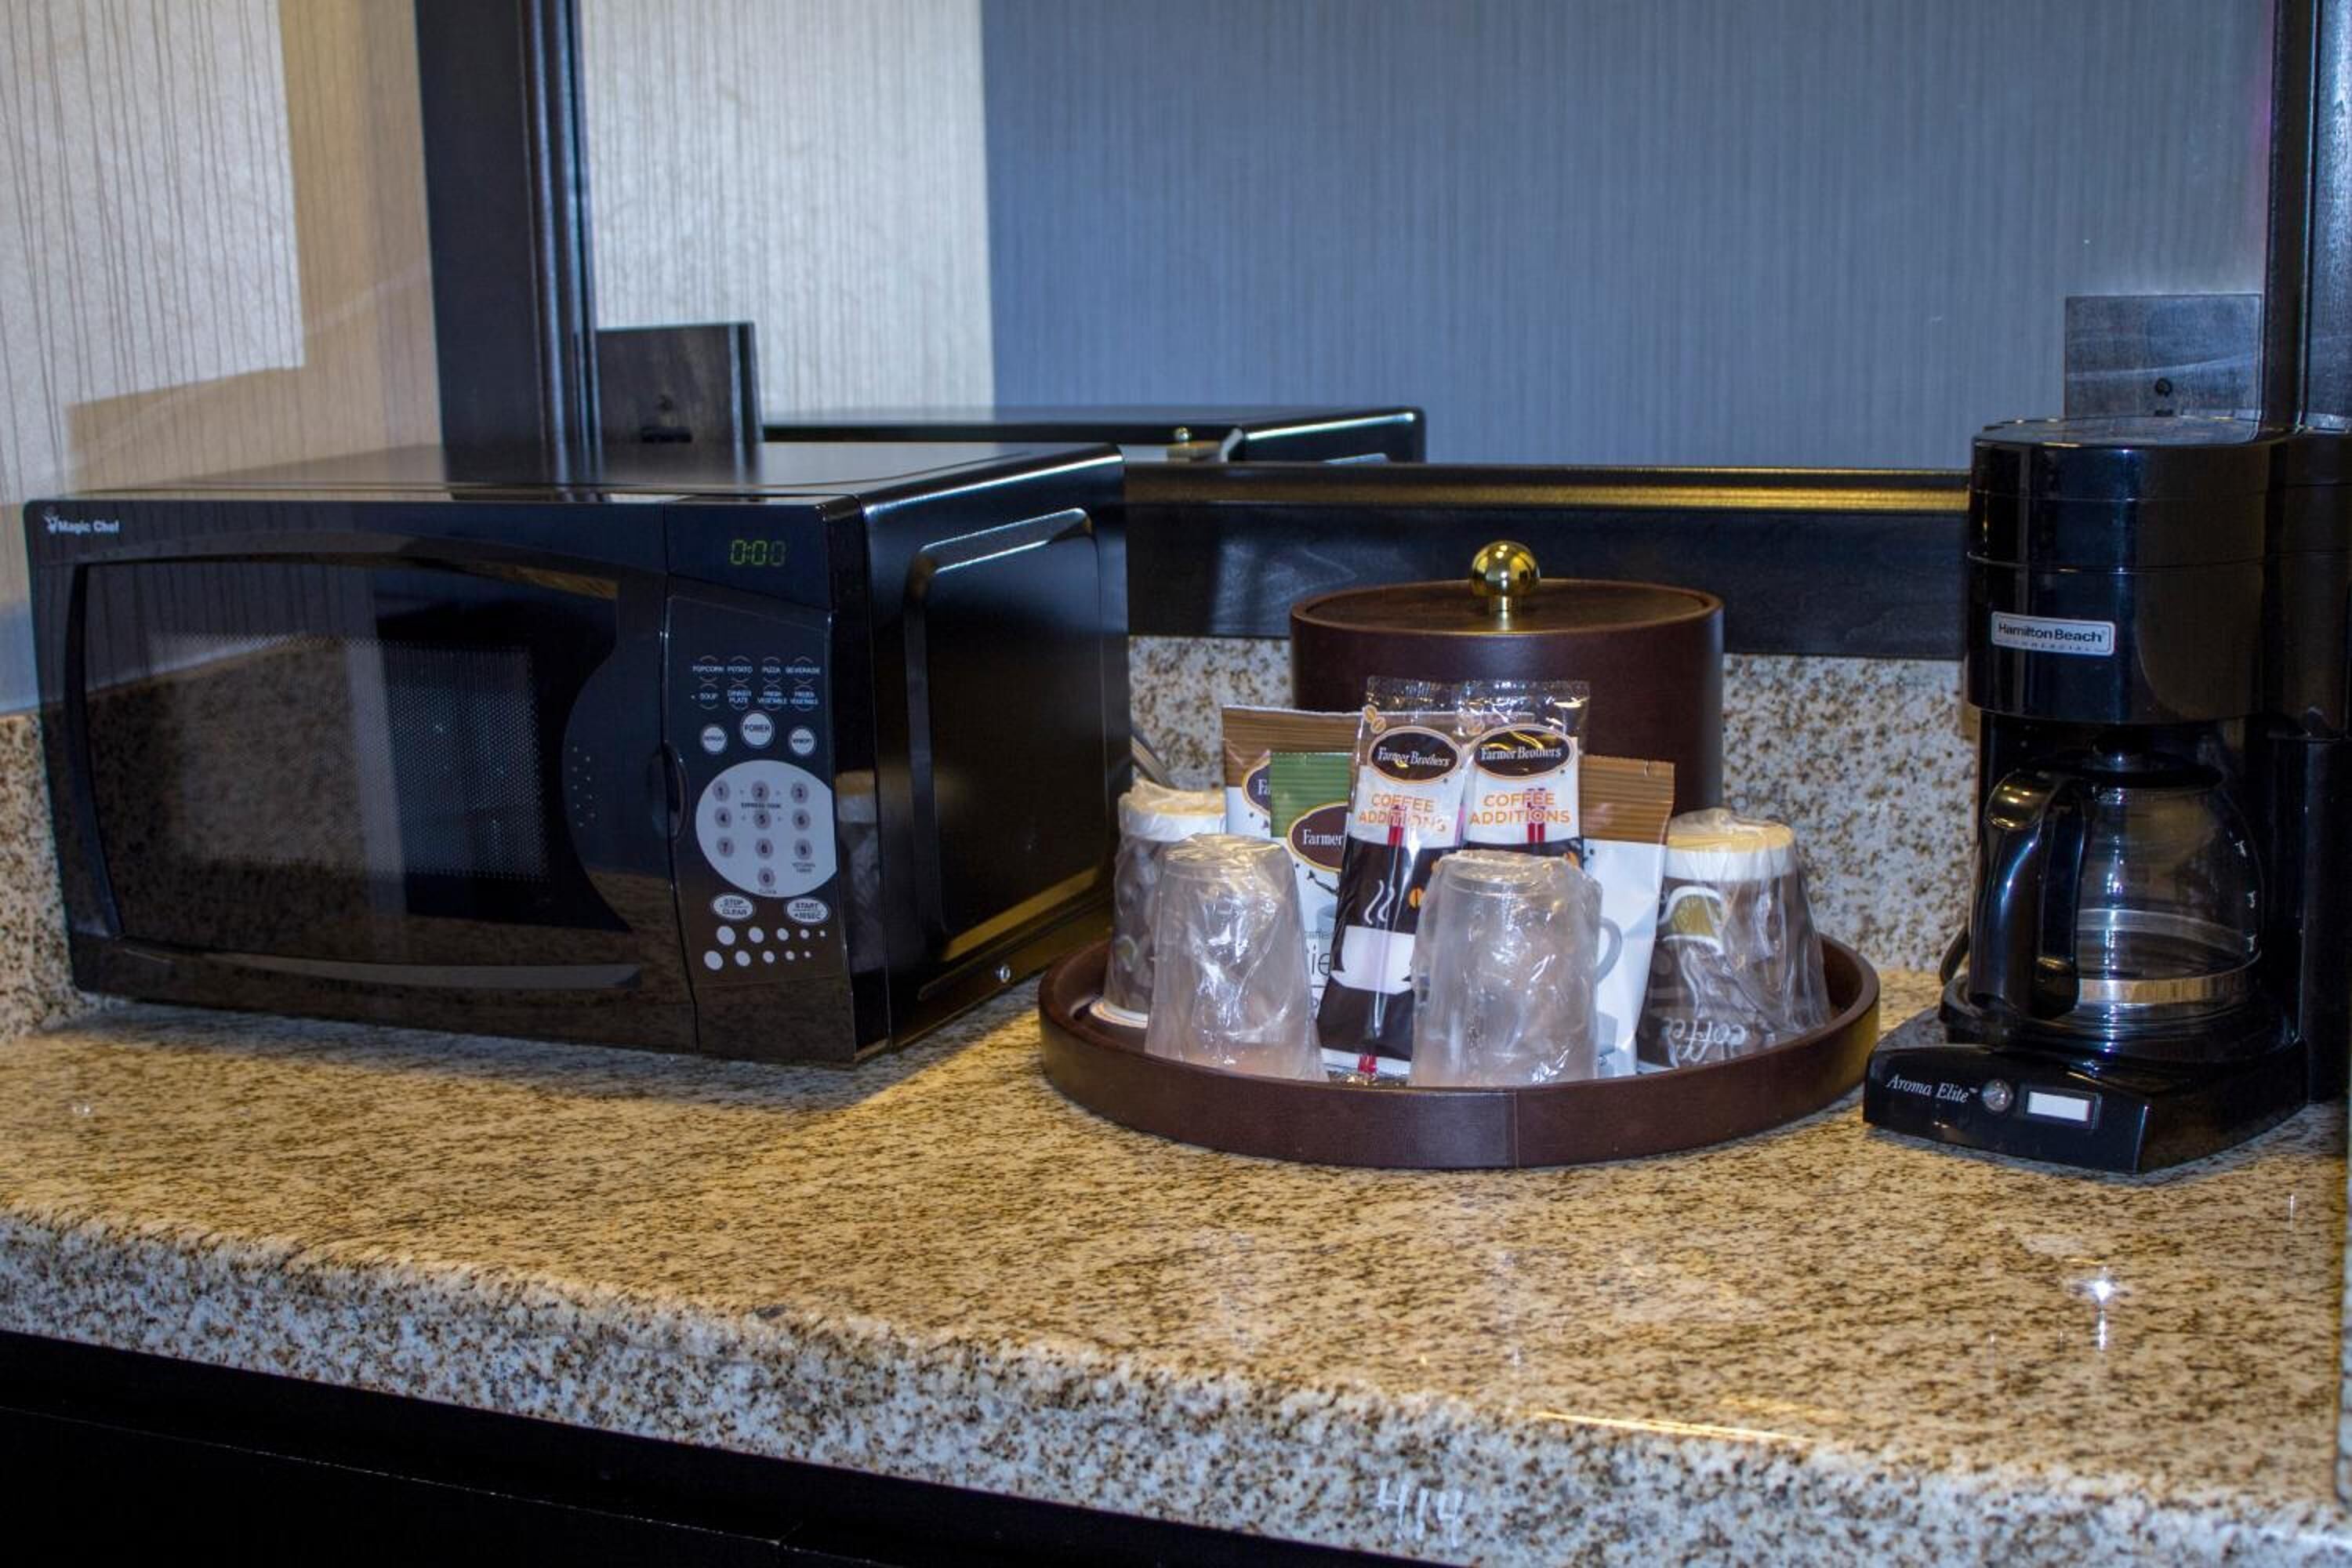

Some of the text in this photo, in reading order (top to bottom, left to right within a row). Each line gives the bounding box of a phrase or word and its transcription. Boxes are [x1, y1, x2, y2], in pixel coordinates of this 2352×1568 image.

[58, 519, 91, 535] Magic
[1998, 622, 2103, 643] Hamilton Beach
[700, 692, 718, 701] SOUP
[1377, 746, 1450, 767] Farmer Brothers
[1480, 745, 1562, 760] Farmer Brothers
[1372, 793, 1435, 813] COFFEE
[1483, 792, 1555, 807] COFFEE
[1359, 809, 1446, 832] ADDITIONS
[1470, 807, 1570, 825] ADDITIONS
[1303, 828, 1343, 846] Farmer
[1886, 1074, 1933, 1097] Aroma
